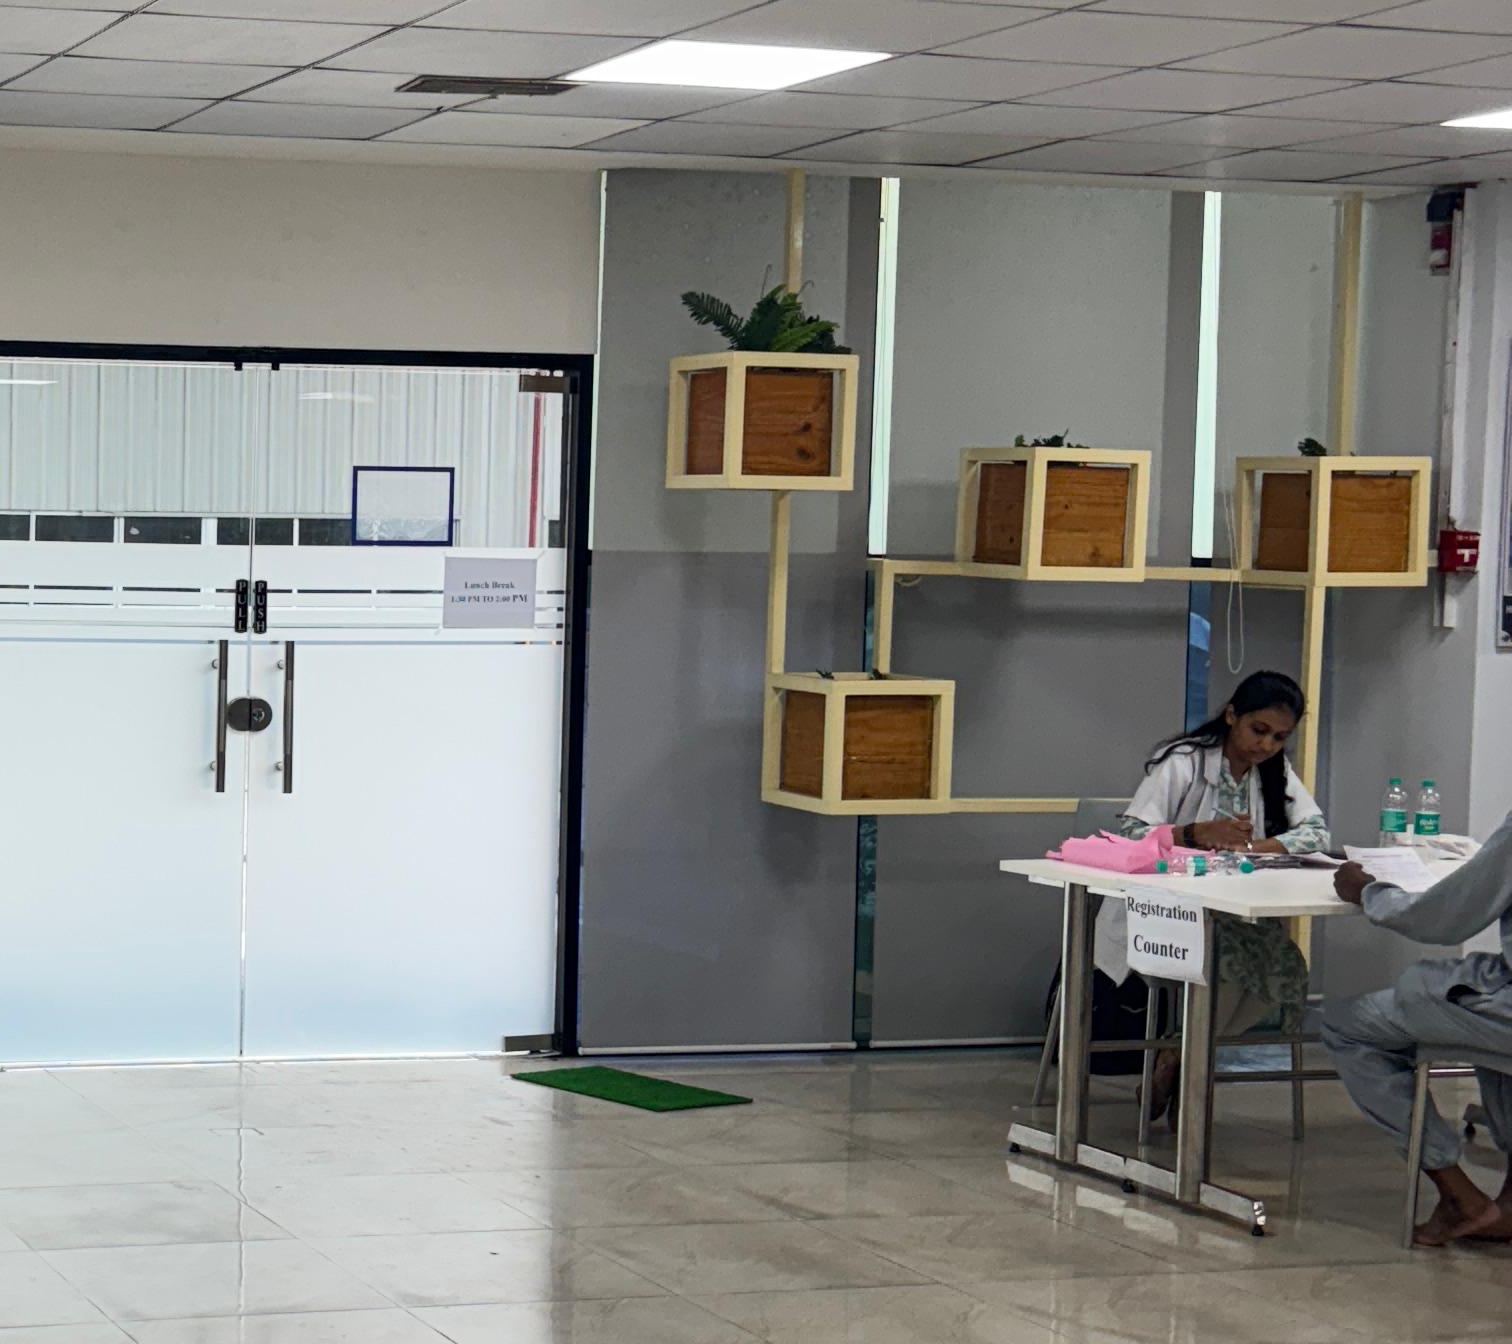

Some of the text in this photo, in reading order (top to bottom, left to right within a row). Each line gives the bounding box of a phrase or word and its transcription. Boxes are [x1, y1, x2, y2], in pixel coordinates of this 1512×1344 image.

[464, 581, 516, 589] Lunch Break
[483, 595, 494, 603] TO
[512, 594, 527, 603] PM
[238, 581, 246, 631] PULL
[257, 582, 265, 632] PUSH
[1127, 896, 1197, 923] Registration
[1134, 934, 1189, 961] Counter
